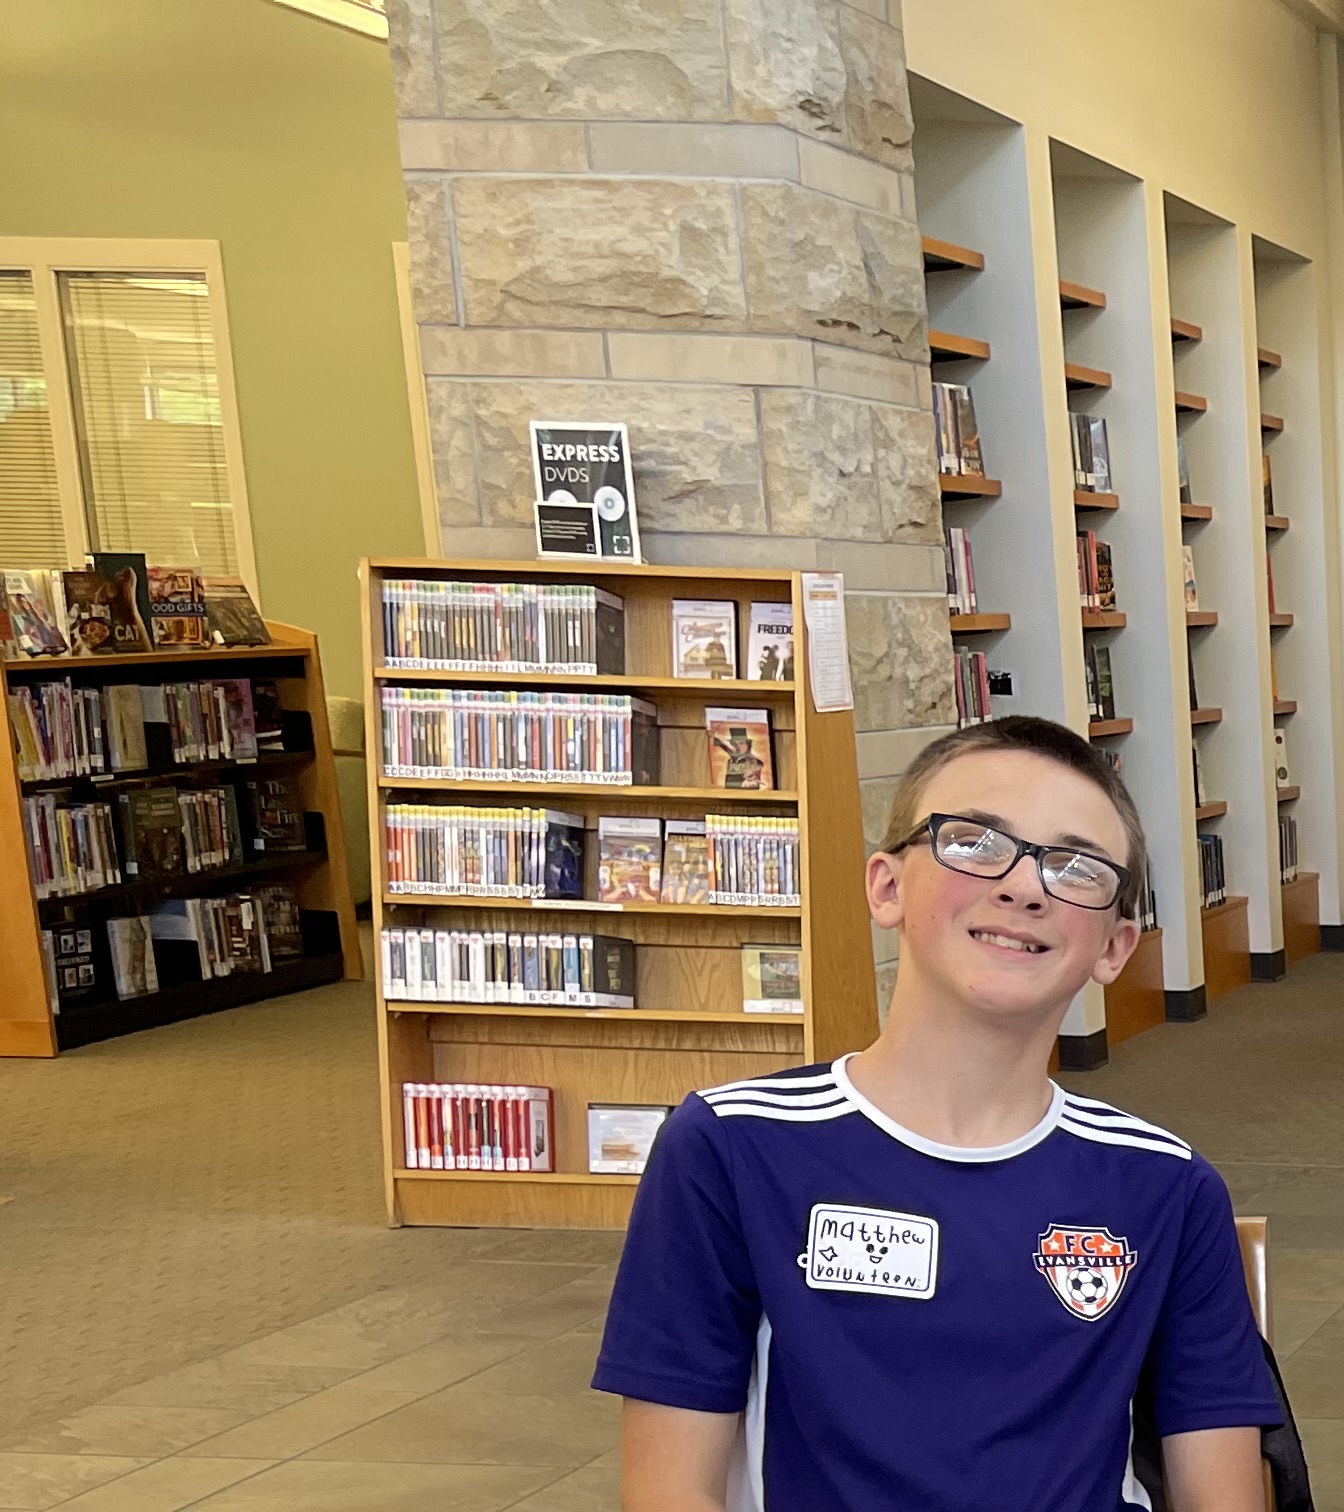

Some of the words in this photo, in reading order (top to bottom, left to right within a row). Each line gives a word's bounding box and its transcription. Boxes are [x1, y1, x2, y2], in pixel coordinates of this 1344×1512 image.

[541, 443, 620, 462] EXPRESS
[544, 467, 590, 483] DVDS
[147, 602, 175, 613] OOD
[176, 602, 204, 613] GIFTS
[114, 624, 141, 642] CAT
[1064, 1235, 1096, 1254] FC
[1037, 1254, 1133, 1267] EVANSVILLE
